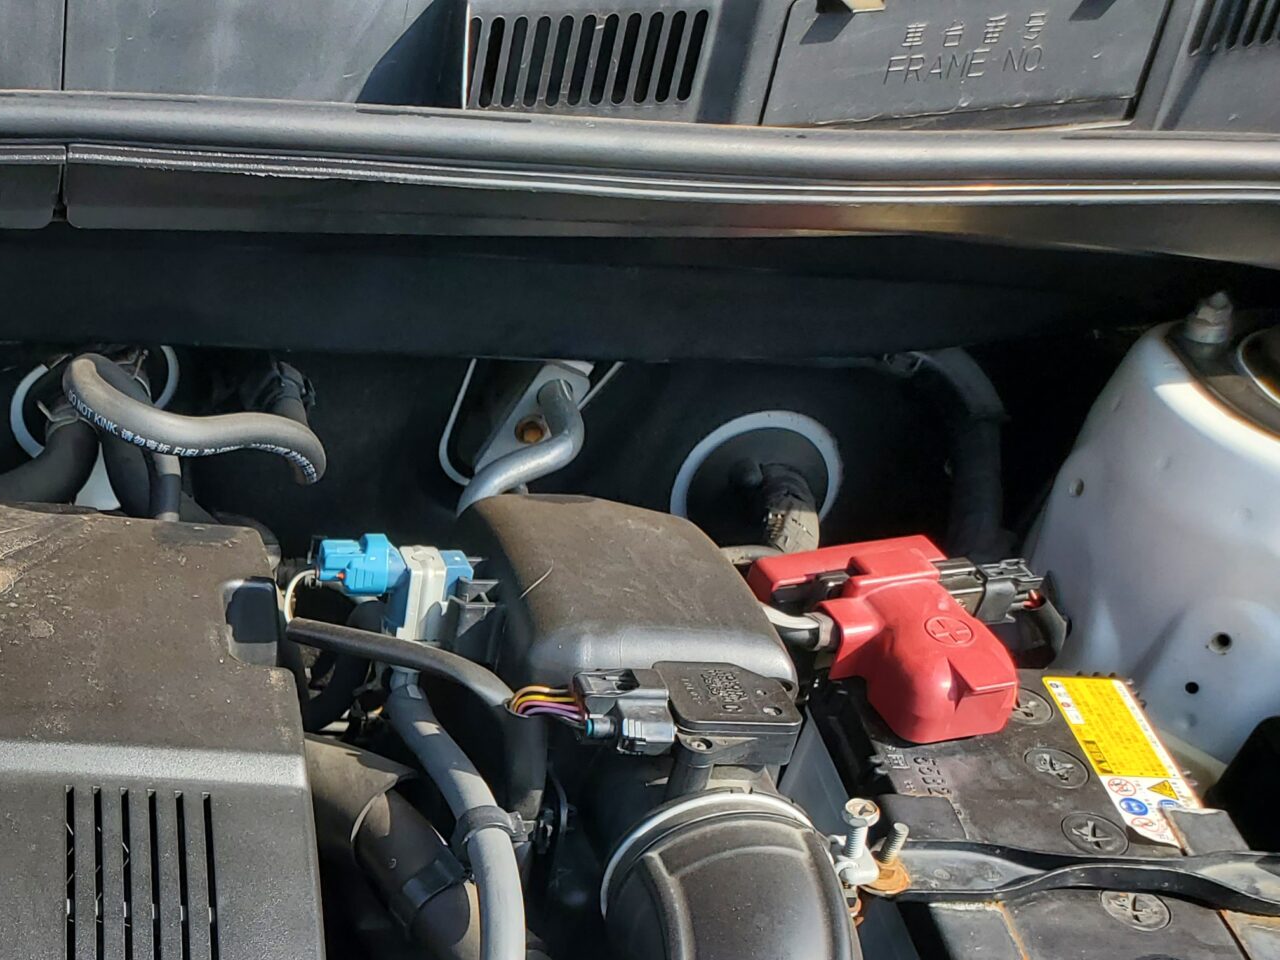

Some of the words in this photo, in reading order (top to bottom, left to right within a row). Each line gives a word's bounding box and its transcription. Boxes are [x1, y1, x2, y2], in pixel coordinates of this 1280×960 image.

[883, 48, 992, 85] FRAME
[77, 401, 94, 420] NOT
[94, 412, 119, 436] KINK.
